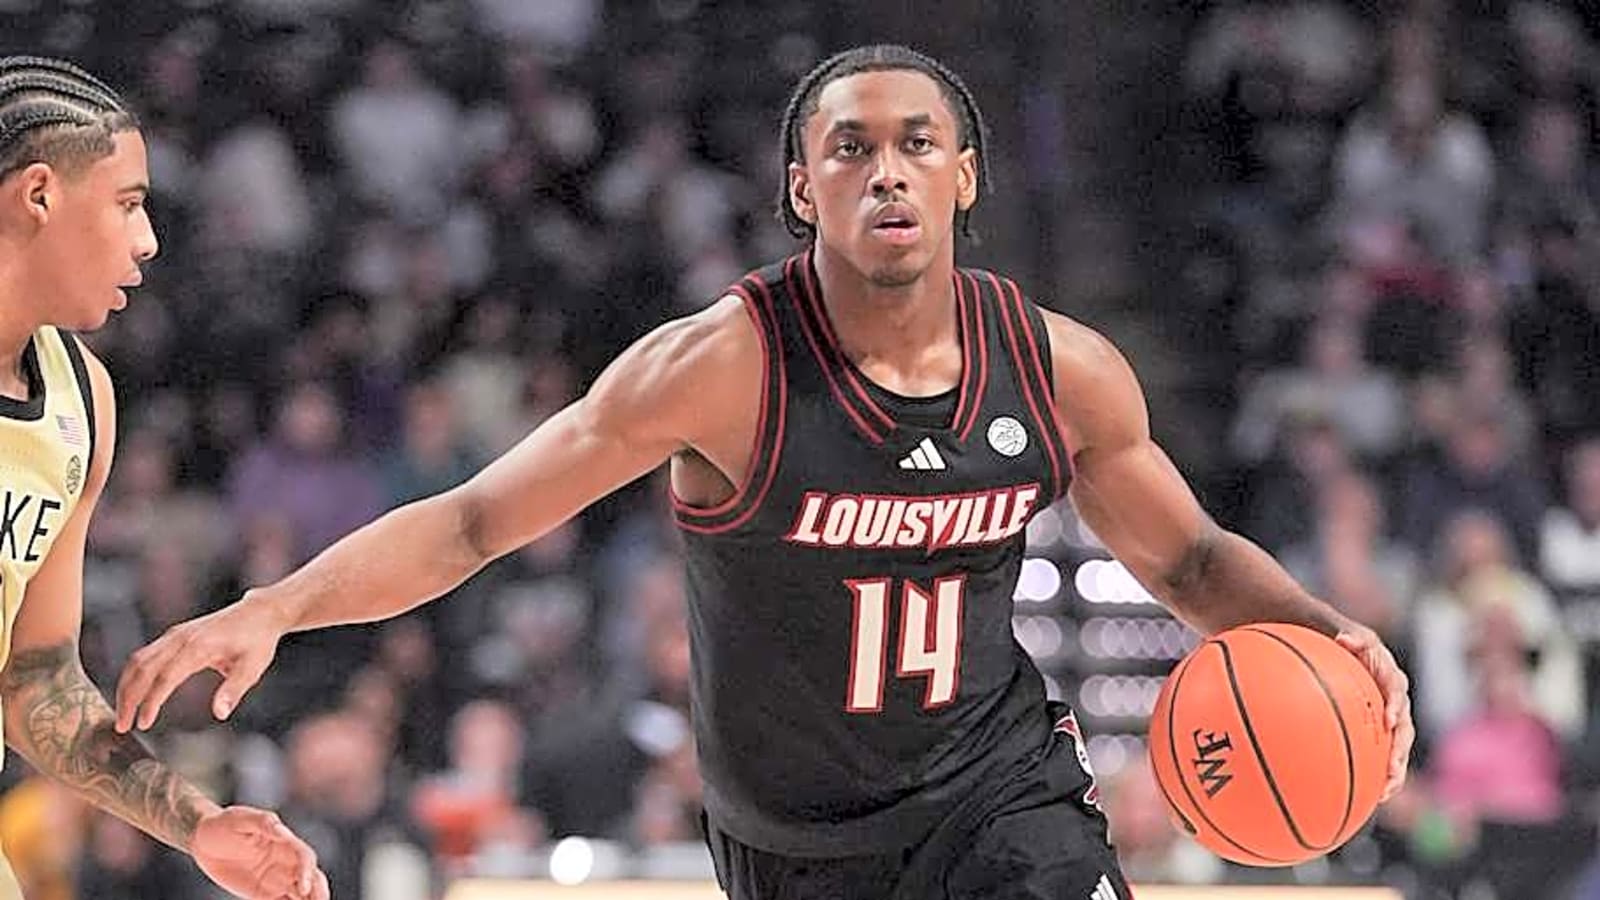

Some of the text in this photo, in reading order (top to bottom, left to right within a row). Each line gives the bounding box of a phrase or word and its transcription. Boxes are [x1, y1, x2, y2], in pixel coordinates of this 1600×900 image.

[785, 483, 1040, 553] LOUISVILLE
[844, 576, 966, 712] 14
[1191, 728, 1233, 800] WF
